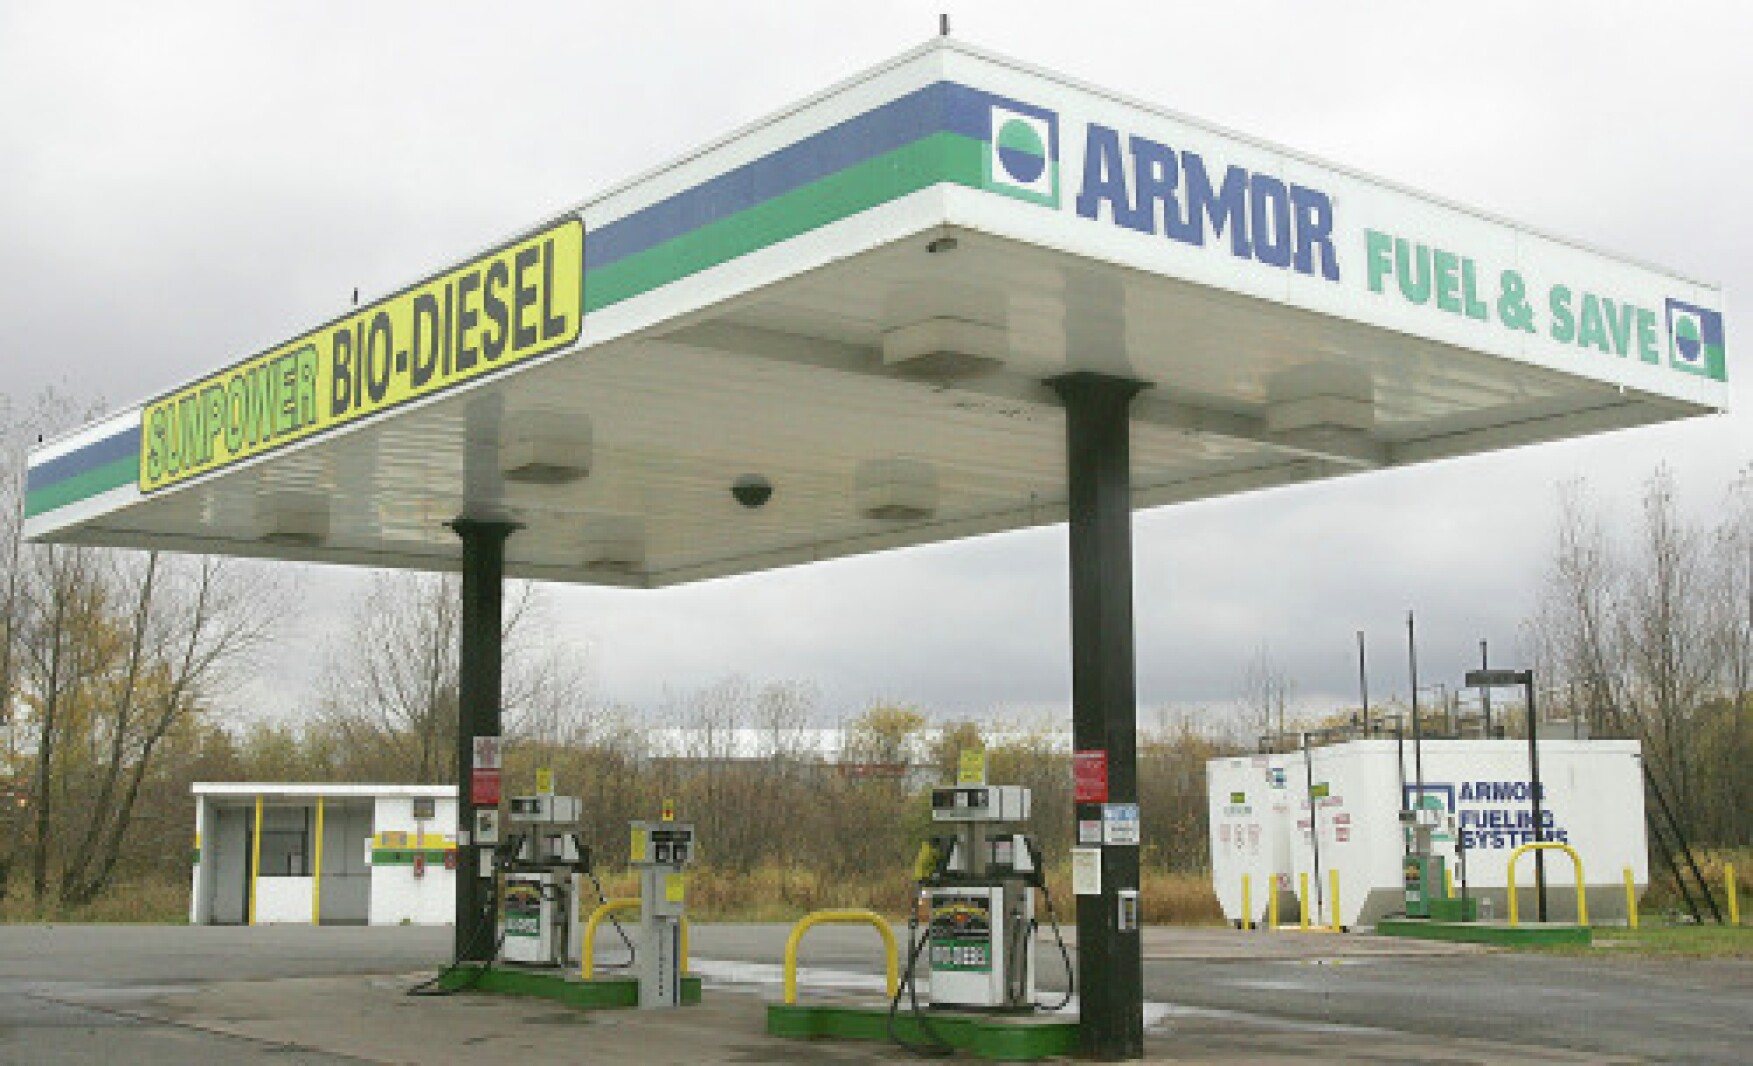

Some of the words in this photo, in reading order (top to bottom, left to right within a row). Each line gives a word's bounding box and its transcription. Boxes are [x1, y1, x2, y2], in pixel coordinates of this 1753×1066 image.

[1076, 123, 1339, 281] ARMOR
[148, 344, 319, 482] SUNPOWER
[331, 238, 566, 418] BIO-DIESEL
[1365, 228, 1488, 321] FUEL
[1498, 270, 1536, 334] &
[1549, 285, 1660, 364] SAVE
[1459, 809, 1554, 829] FUELING
